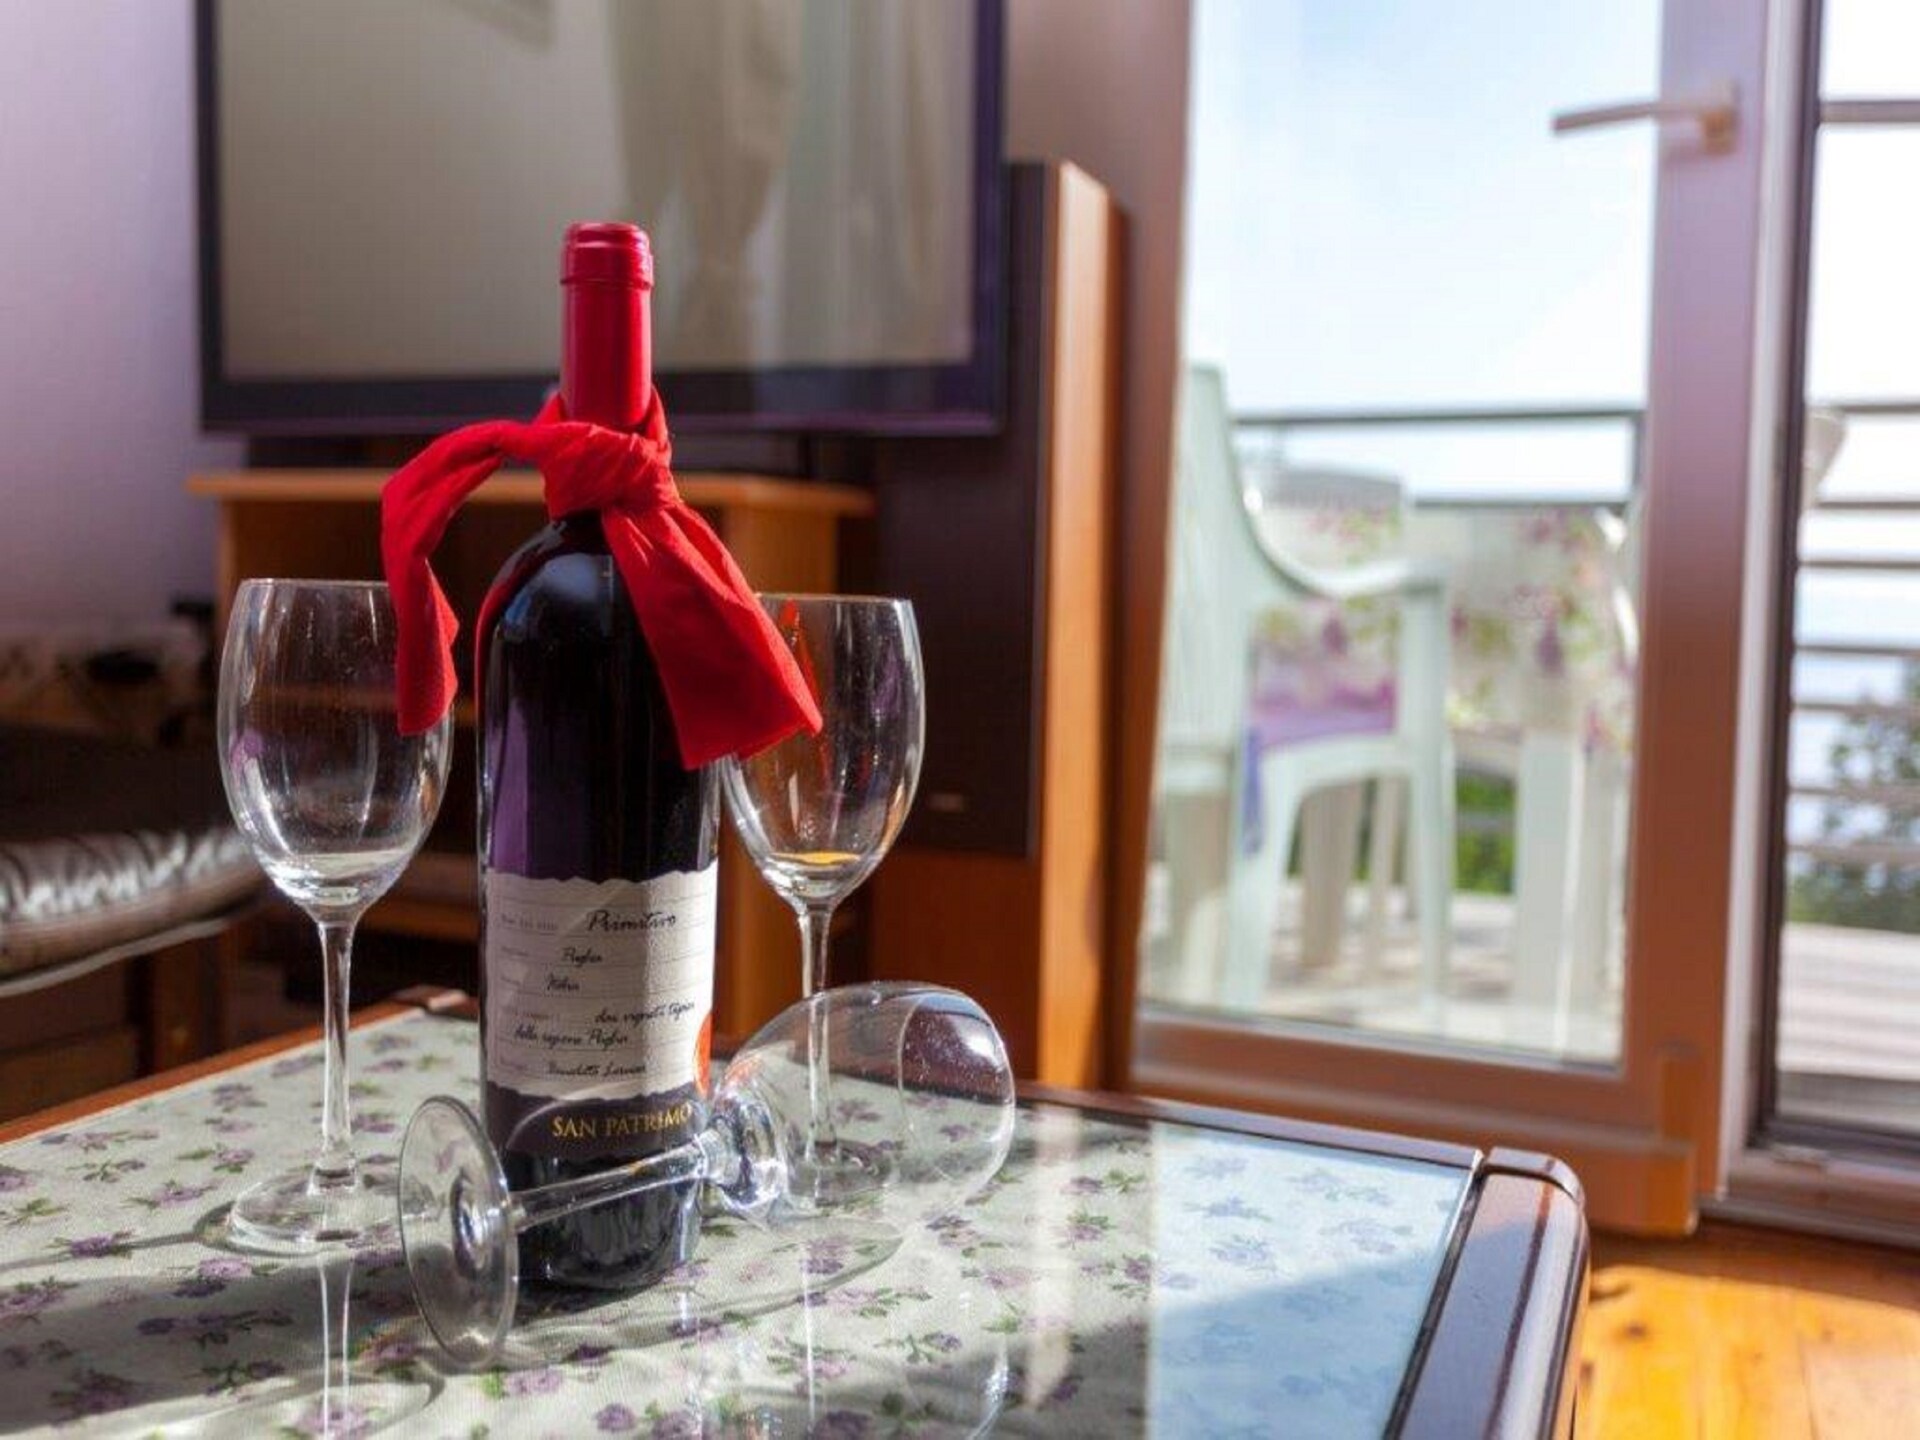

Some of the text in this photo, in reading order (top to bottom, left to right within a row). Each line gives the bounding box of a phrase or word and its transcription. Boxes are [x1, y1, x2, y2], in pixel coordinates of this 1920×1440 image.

[588, 909, 676, 932] Primitivo
[553, 1101, 692, 1139] SAN PATRIMO
